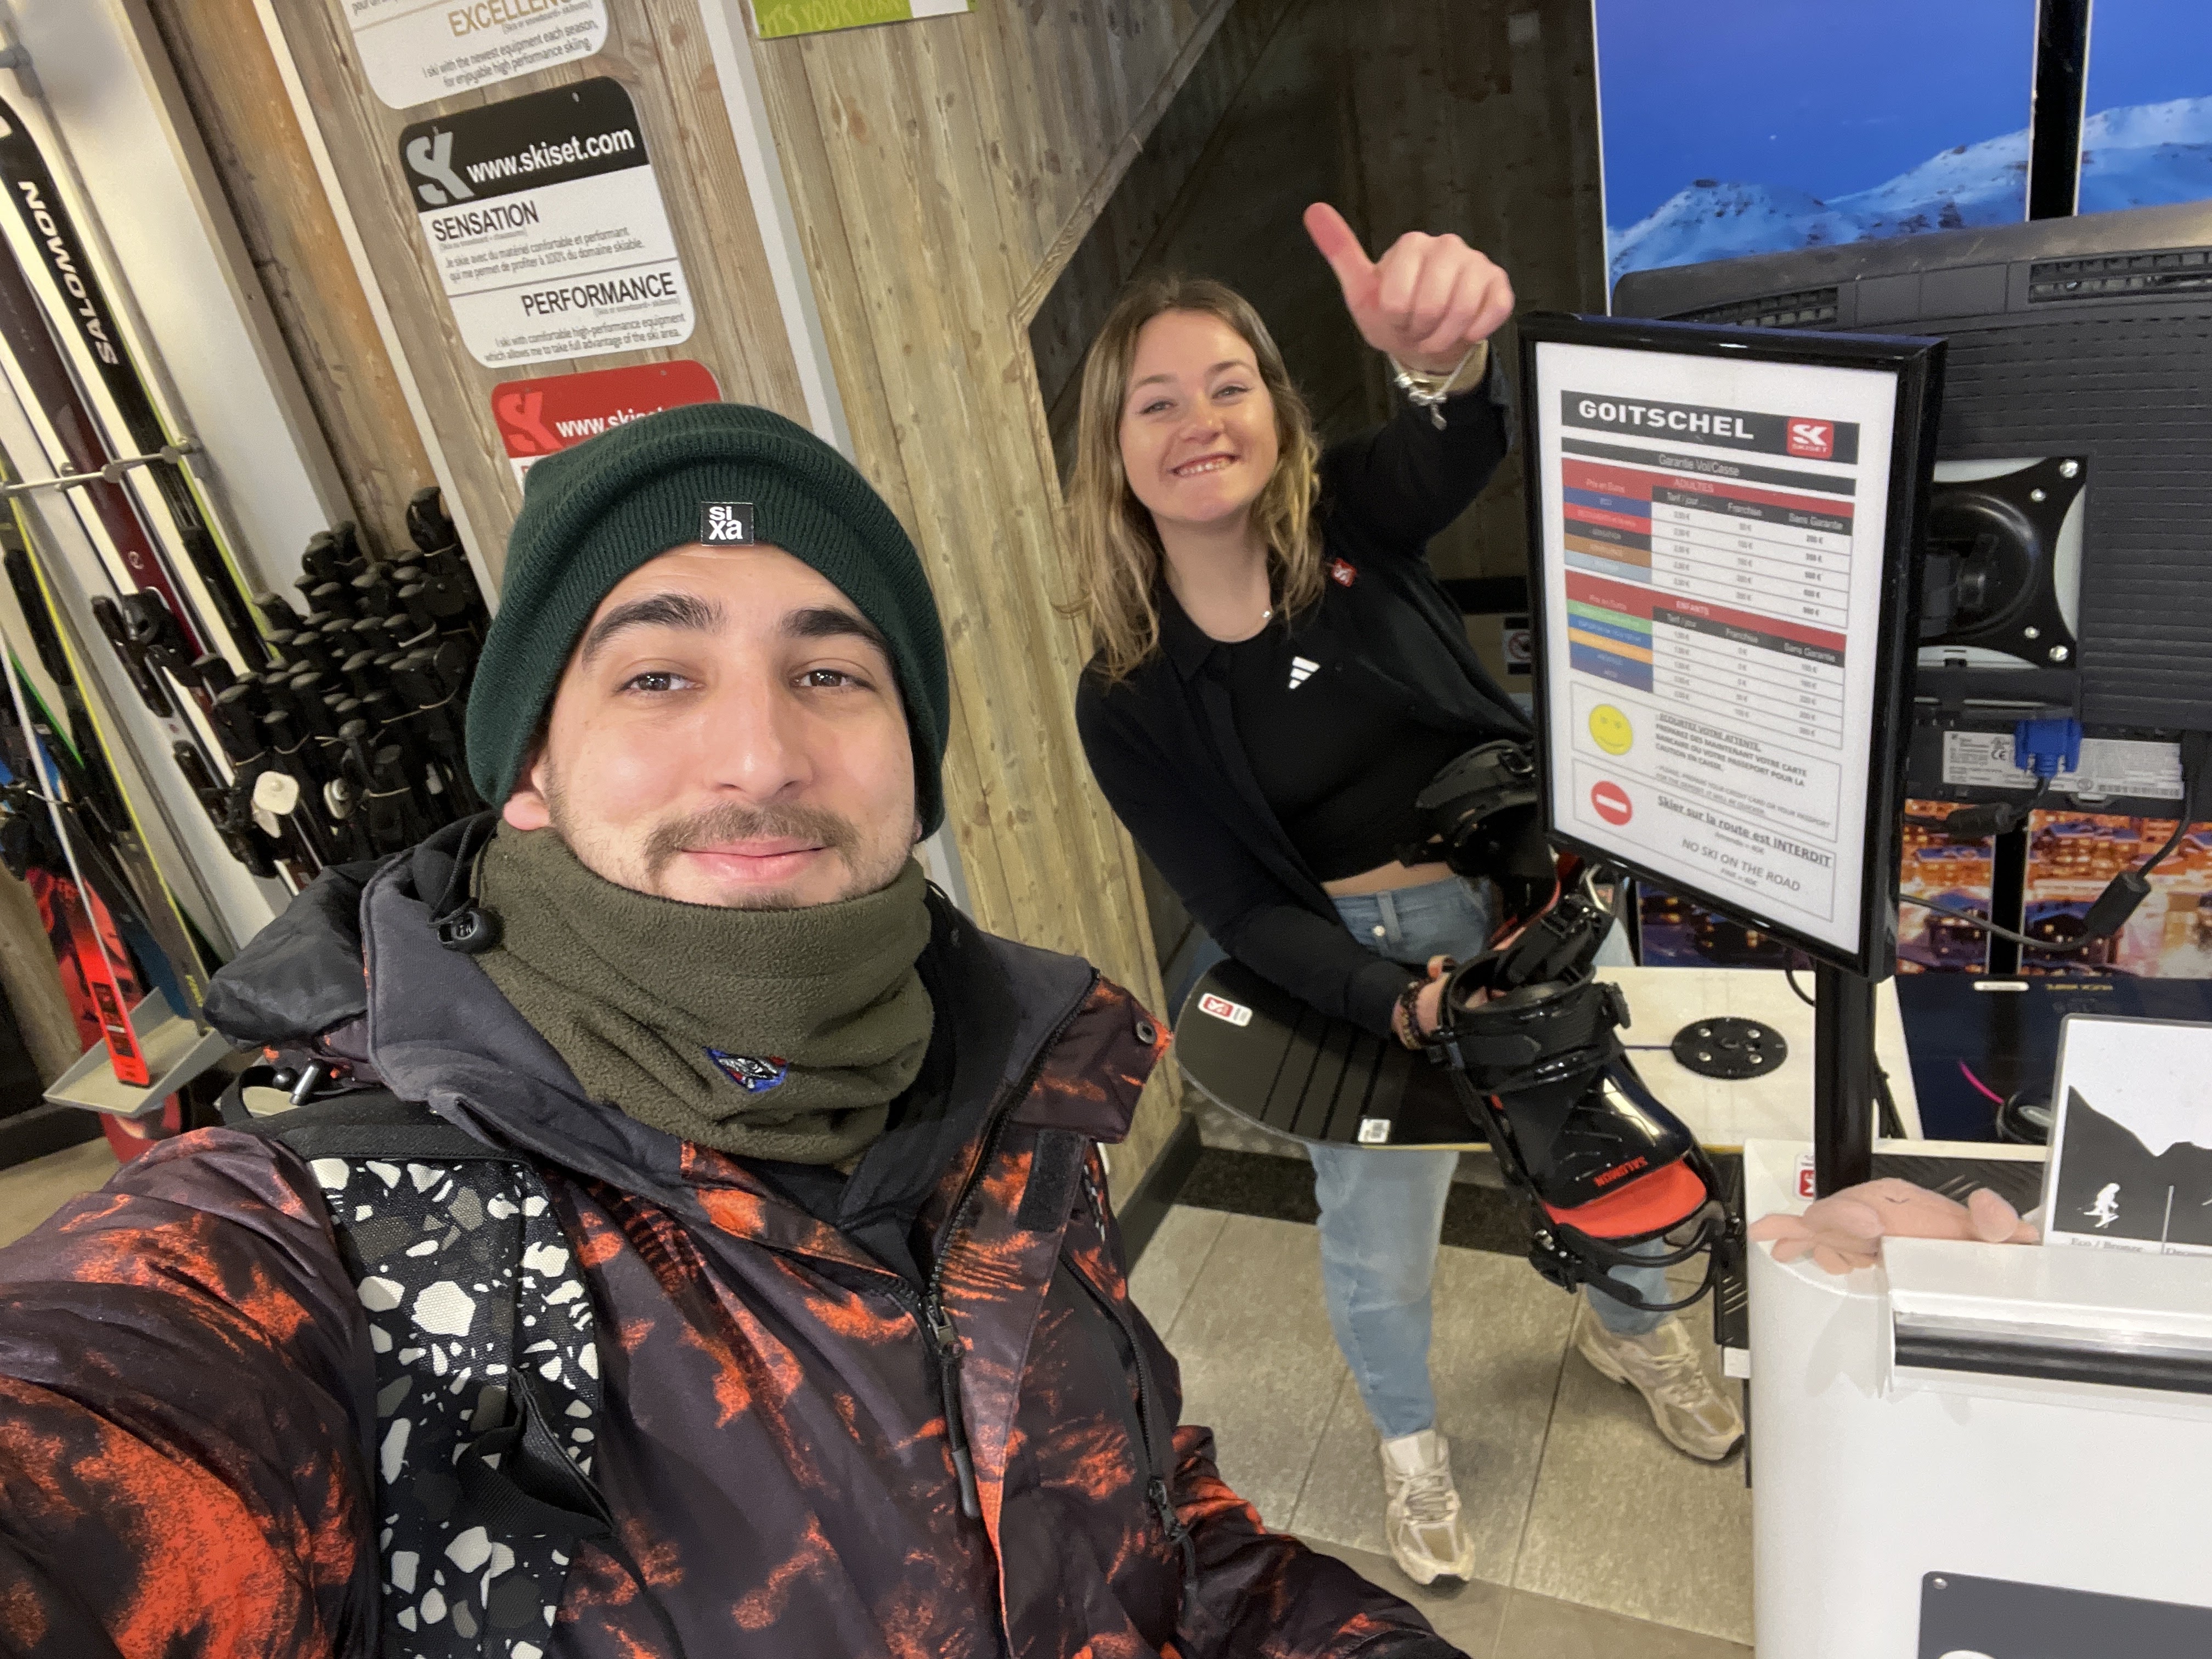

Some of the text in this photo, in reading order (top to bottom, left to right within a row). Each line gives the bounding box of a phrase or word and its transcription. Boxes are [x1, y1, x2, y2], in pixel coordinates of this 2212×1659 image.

[467, 128, 635, 184] www.skiset.com
[432, 200, 540, 242] SENSATION
[470, 253, 488, 263] avec
[577, 241, 612, 258] domaine
[18, 182, 119, 364] SALOMON
[521, 272, 677, 317] PERFORMANCE
[1578, 399, 1754, 439] GOITSCHEL
[709, 506, 732, 521] si
[709, 520, 743, 540] xa
[1658, 794, 1831, 868] Skier sur la route est INTERDIT
[1681, 838, 1800, 892] NO SKI ON THE ROAD
